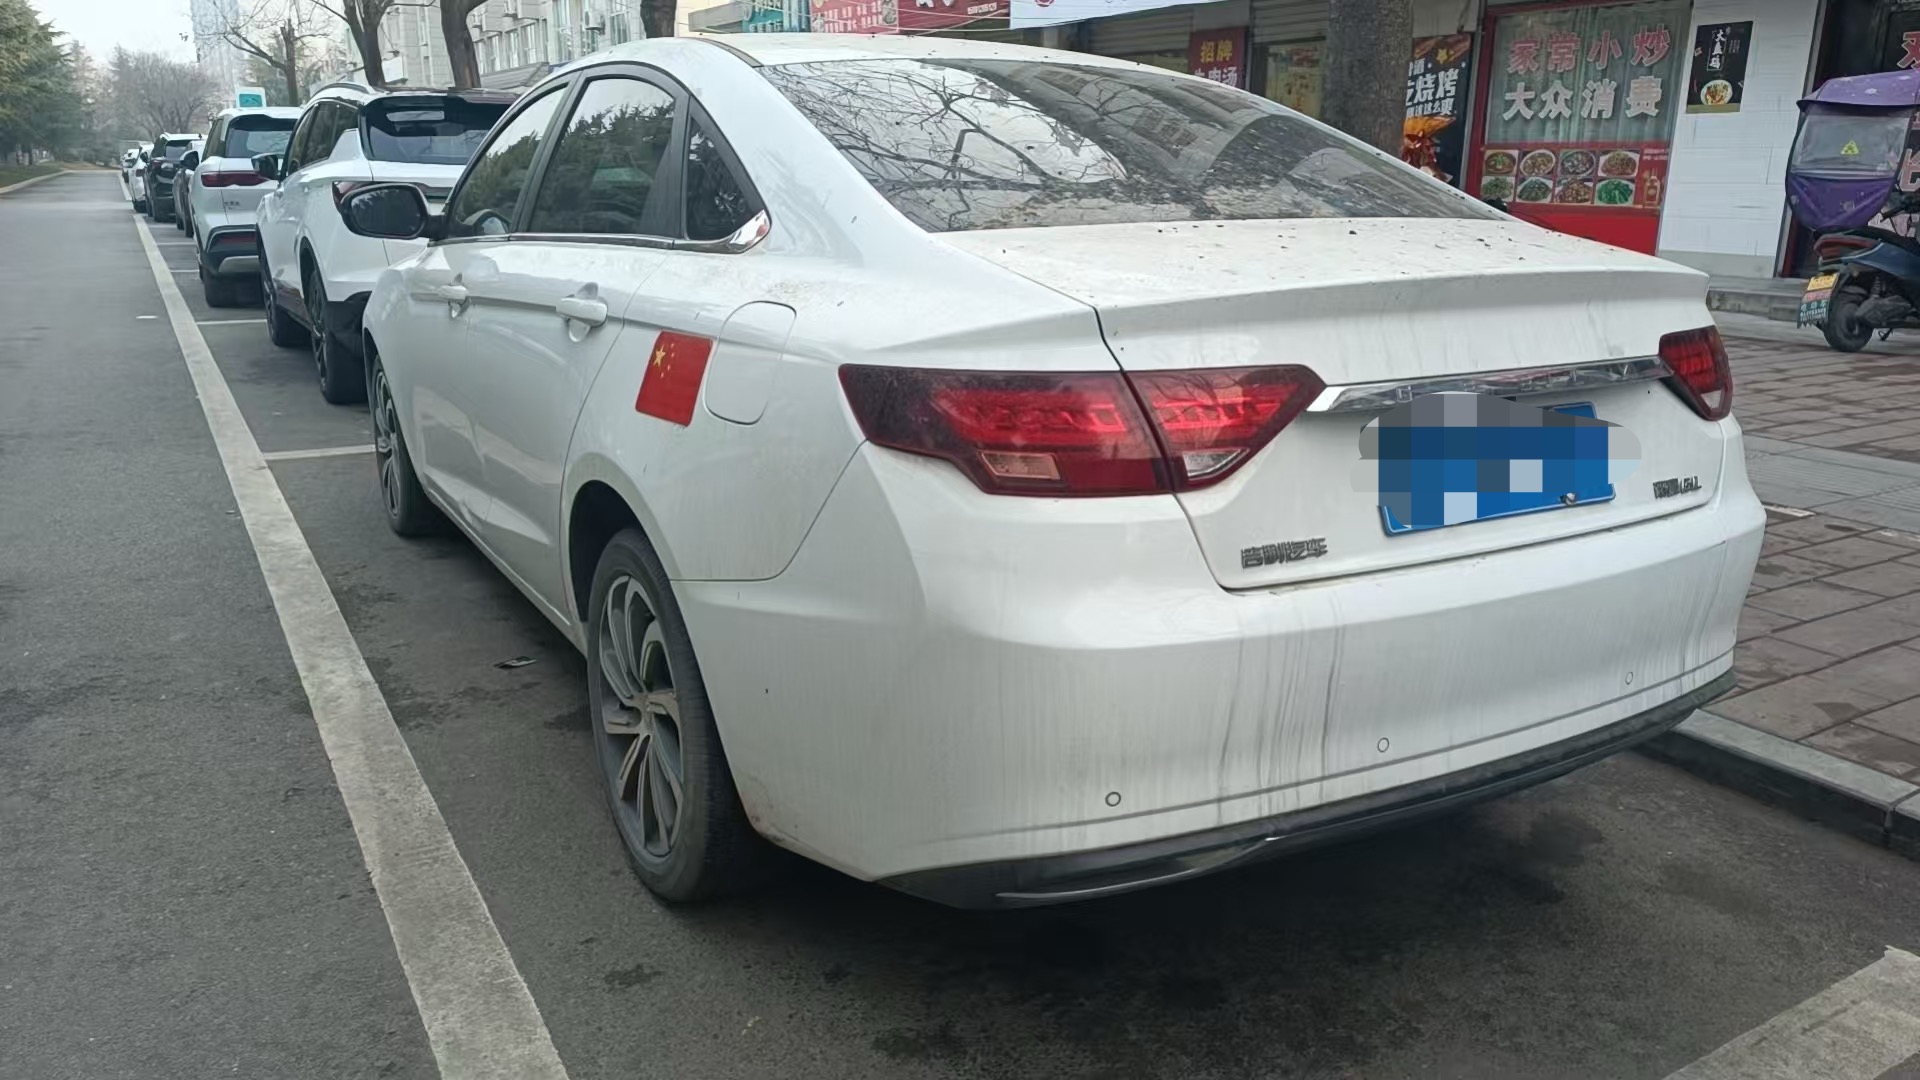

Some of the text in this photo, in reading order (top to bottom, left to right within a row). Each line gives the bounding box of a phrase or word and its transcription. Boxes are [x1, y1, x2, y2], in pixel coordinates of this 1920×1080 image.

[1200, 40, 1233, 63] 招牌
[1507, 24, 1671, 75] 家常小炒
[1502, 75, 1663, 121] 大众消费
